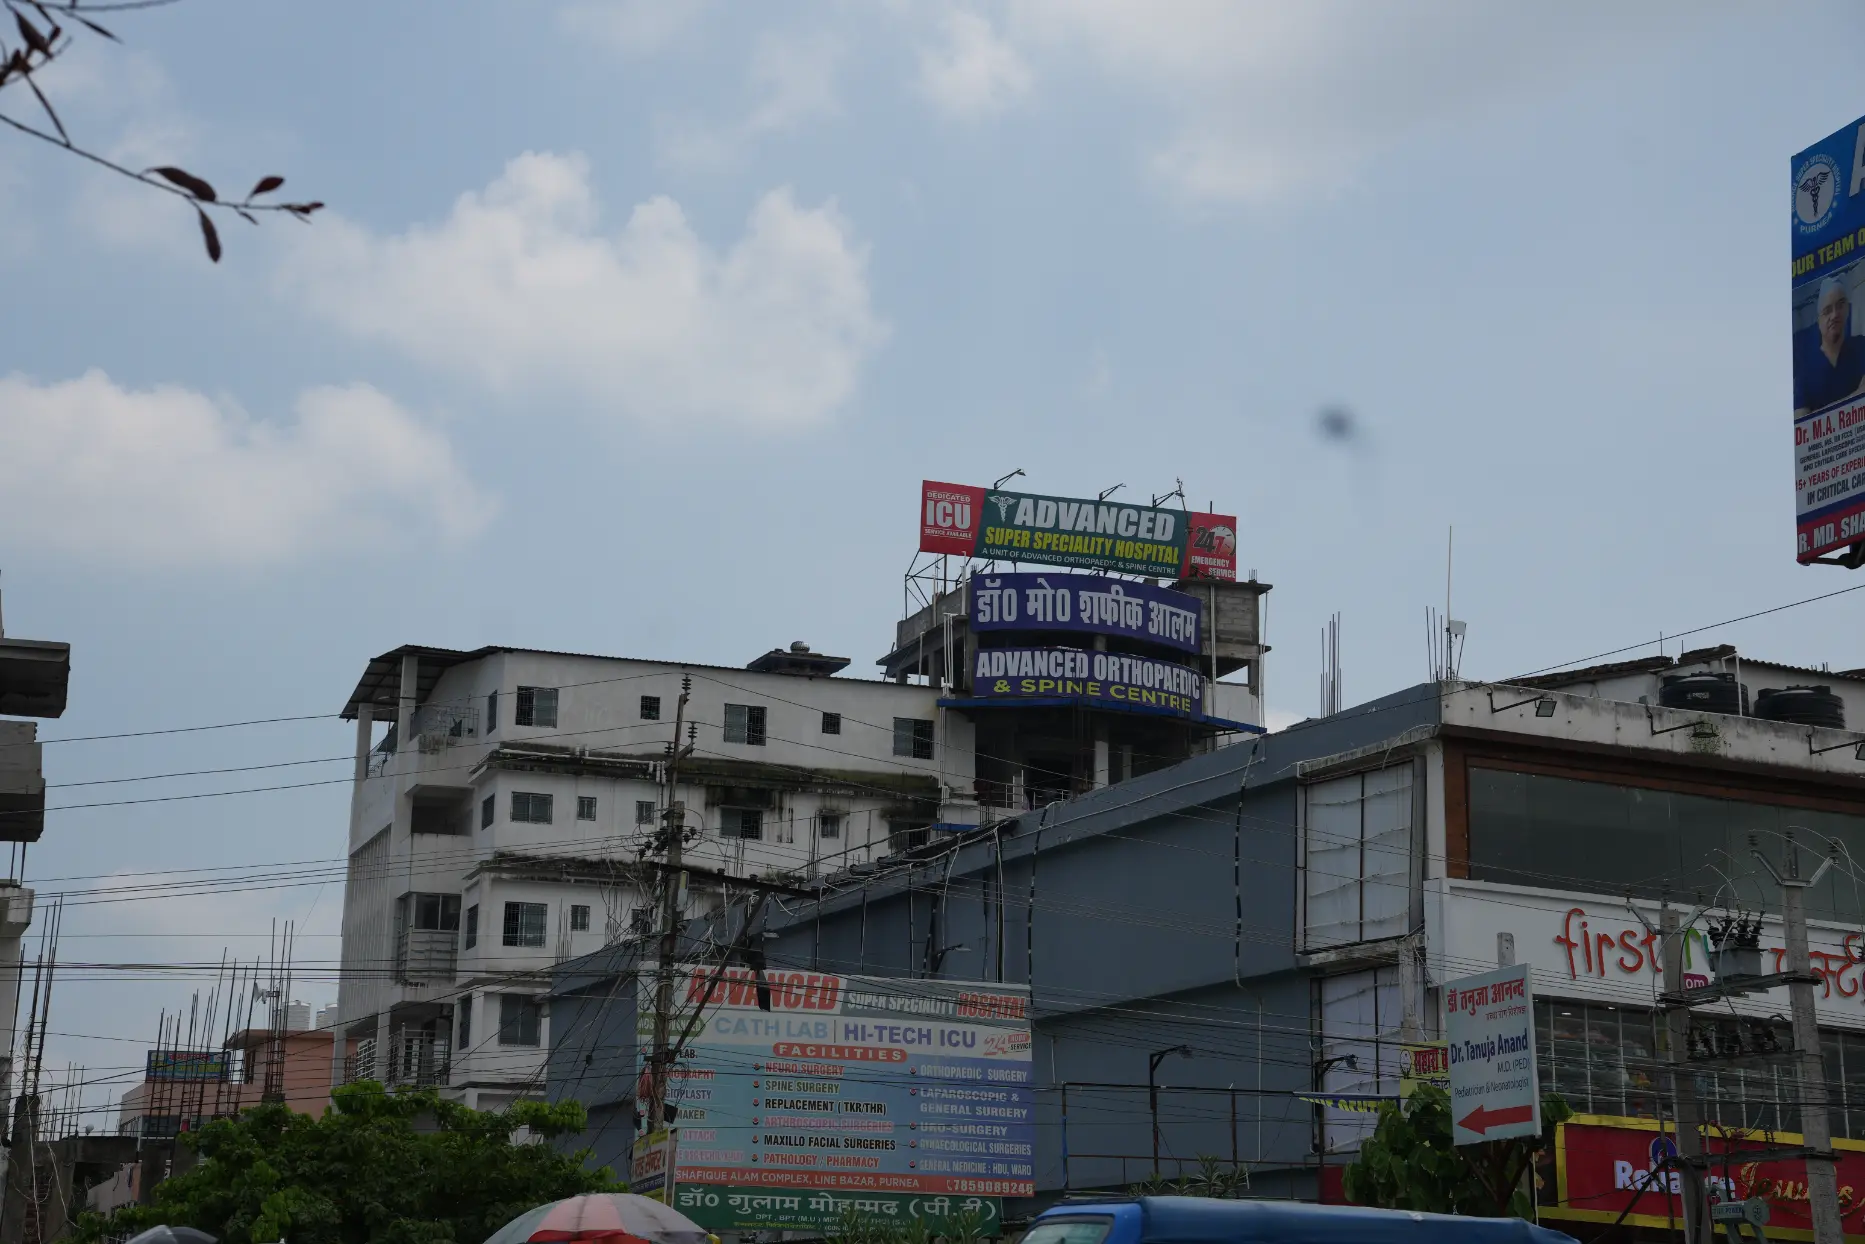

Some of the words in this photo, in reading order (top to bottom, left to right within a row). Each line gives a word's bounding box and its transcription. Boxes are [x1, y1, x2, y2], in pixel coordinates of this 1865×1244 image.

[1817, 233, 1854, 265] TEAM
[1795, 426, 1809, 446] Dr.
[1812, 415, 1836, 440] M.A.
[1838, 405, 1865, 430] Rahm
[1808, 470, 1830, 486] YEARS
[1831, 465, 1840, 479] OF
[1841, 455, 1865, 476] EXPERI
[927, 491, 971, 503] DEDICATED
[1817, 478, 1850, 502] CRITICAL
[926, 499, 971, 529] ICU
[1013, 498, 1175, 542] ADVANCED
[1813, 521, 1838, 547] MD.
[1840, 510, 1865, 539] SHA
[985, 527, 1033, 550] SUPER
[1034, 530, 1113, 556] SPECIALITY
[1115, 537, 1180, 565] HOSPITAL
[982, 547, 989, 555] A
[989, 548, 1008, 557] UNIT
[1009, 550, 1020, 558] OF
[1021, 551, 1062, 563] ADVANCED
[1064, 556, 1116, 568] ORTHOPAEDIC
[1118, 561, 1124, 569] &
[1125, 562, 1147, 571] SPINE
[1148, 564, 1176, 575] CENTRE
[1191, 556, 1230, 568] EMERGENCY
[1208, 567, 1236, 579] SERVICE
[1148, 600, 1197, 645] आलम
[976, 652, 1089, 679] ADVANCED
[1093, 653, 1200, 700] ORTHOPAEDIC
[993, 680, 1011, 693] &
[1020, 679, 1101, 697] SPINE
[1109, 685, 1192, 713] CENTRE
[685, 968, 840, 1011] ADVANCED
[1447, 987, 1458, 1013] डॉ
[1459, 985, 1489, 1016] तनुजा
[1490, 977, 1525, 1004] आनन्द
[847, 992, 888, 1011] SUPER
[889, 994, 956, 1016] SPECIALITY
[956, 990, 1027, 1021] HOSPITAL
[714, 1017, 780, 1038] CATH
[786, 1018, 829, 1039] LAB
[844, 1022, 932, 1046] HI-TECH
[939, 1029, 976, 1049] ICU
[779, 1044, 903, 1061] FACILITIES
[1450, 1043, 1465, 1065] Dr.
[1465, 1036, 1496, 1064] Tanuja
[1497, 1028, 1529, 1057] Anand
[764, 1062, 798, 1074] NEURO
[800, 1063, 845, 1077] SURGERY
[920, 1064, 983, 1078] ORTHOPAEDIC
[987, 1068, 1027, 1083] SURGERY
[1497, 1061, 1512, 1075] M.D.
[764, 1080, 794, 1091] SPINE
[796, 1081, 840, 1094] SURGERY
[920, 1087, 1008, 1103] LAPAROSCOPIC
[1010, 1093, 1020, 1103] &
[1454, 1083, 1486, 1100] Pediatrician
[764, 1098, 835, 1112] REPLACEMENT
[920, 1102, 972, 1116] GENERAL
[975, 1105, 1028, 1119] SURGERY
[683, 1129, 716, 1142] ATTACK
[841, 1119, 895, 1133] SURGERIES
[920, 1122, 1008, 1137] URO-SURGERY
[763, 1134, 805, 1147] MAXILLO
[808, 1136, 841, 1149] FACIAL
[843, 1138, 896, 1151] SURGERIES
[989, 1142, 1032, 1156] SURGERIES
[763, 1153, 818, 1166] PATHOLOGY
[826, 1155, 880, 1169] PHARMACY
[920, 1158, 951, 1172] GENERAL
[952, 1160, 987, 1174] MEDICINE
[992, 1163, 1010, 1177] HDU,
[675, 1170, 728, 1181] SHAFIQUE
[730, 1171, 759, 1183] ALAM
[761, 1173, 812, 1185] COMPLEX,
[814, 1174, 837, 1185] LINE
[839, 1175, 877, 1188] BAZAR,
[879, 1178, 920, 1189] PURNEA
[727, 1193, 802, 1215] गुलाम
[755, 1213, 773, 1221] DPT
[779, 1214, 796, 1222] BPT
